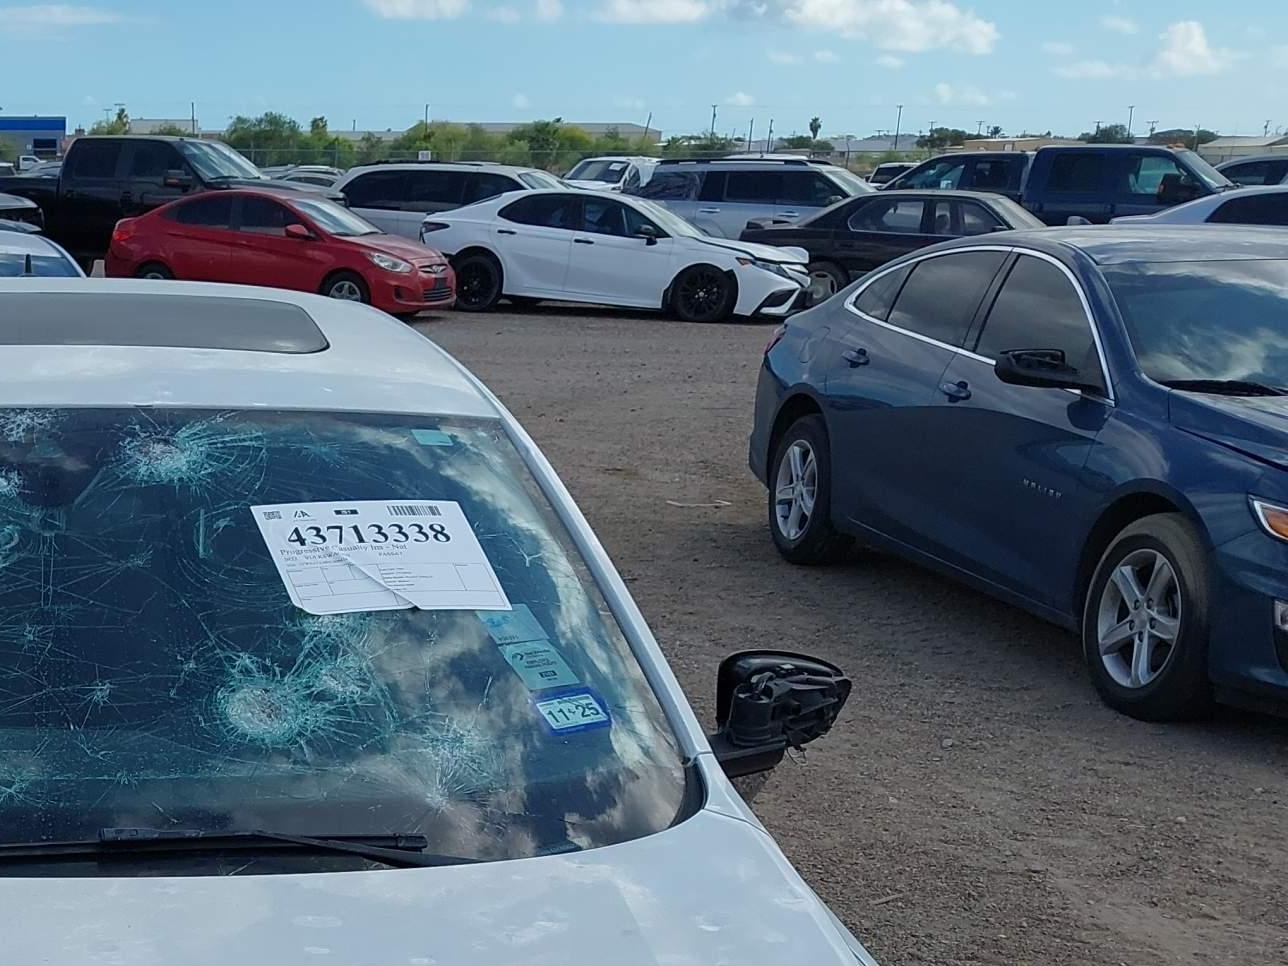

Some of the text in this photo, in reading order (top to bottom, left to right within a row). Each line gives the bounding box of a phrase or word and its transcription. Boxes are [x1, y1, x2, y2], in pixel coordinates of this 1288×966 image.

[1023, 477, 1062, 498] MALIBU
[288, 523, 451, 547] 43713338
[280, 544, 330, 556] Progressive
